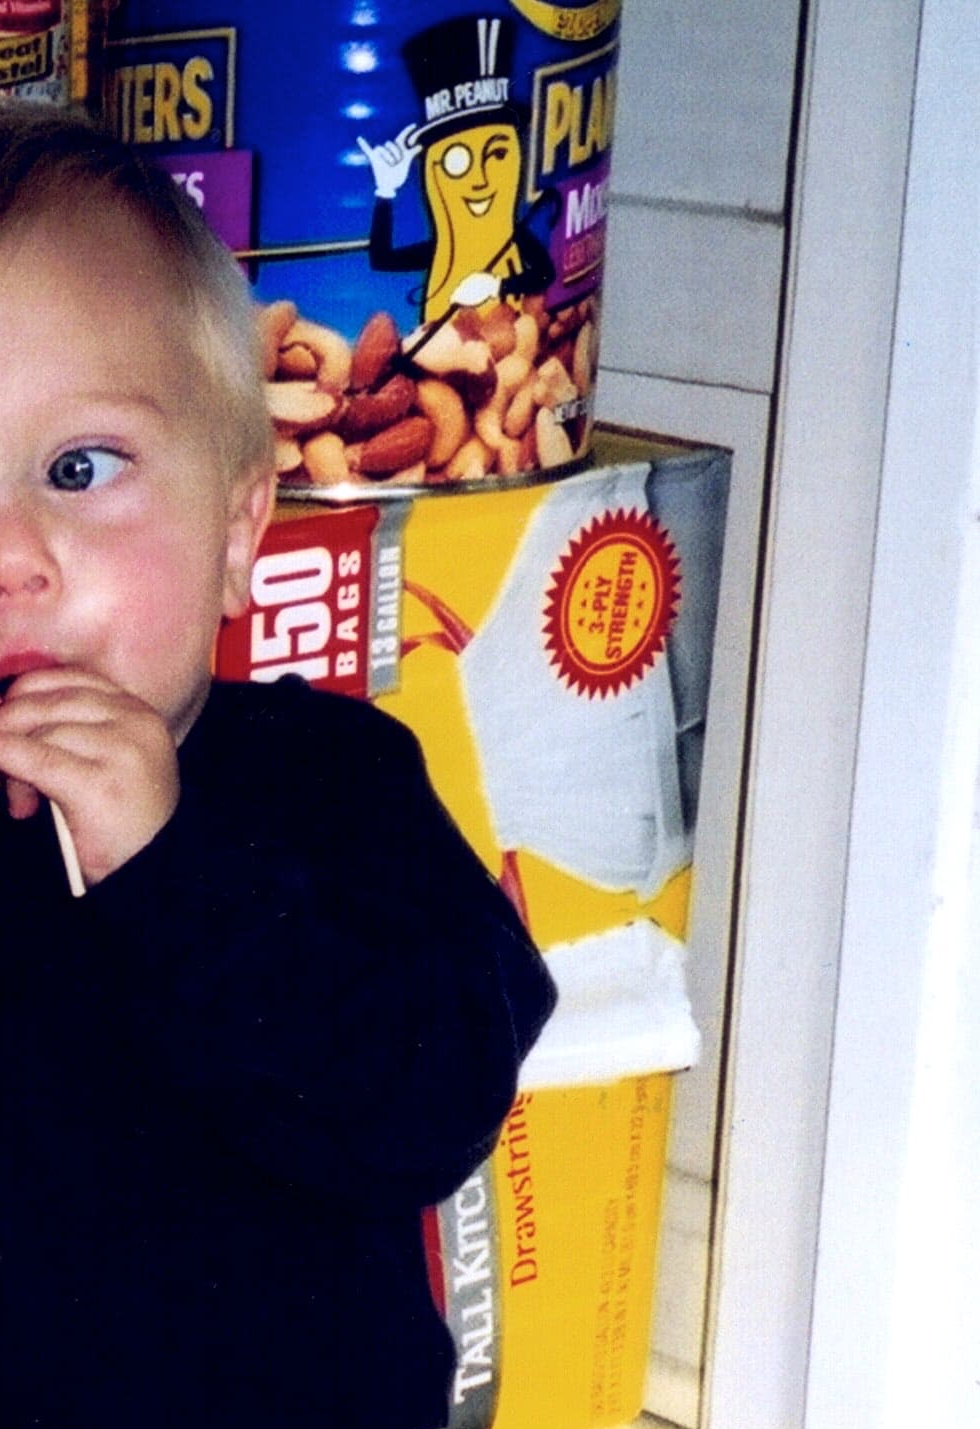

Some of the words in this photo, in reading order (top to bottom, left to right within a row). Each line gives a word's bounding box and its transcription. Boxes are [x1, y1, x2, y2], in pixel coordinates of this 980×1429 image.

[116, 56, 214, 143] TERS
[425, 88, 454, 121] MR.
[454, 77, 509, 108] PEANUT
[335, 550, 361, 677] BAGS
[372, 636, 399, 670] 13
[588, 575, 613, 634] 3-PLY
[604, 551, 638, 660] STRENGTH
[453, 1176, 492, 1295] KITC
[454, 1289, 493, 1405] TALL
